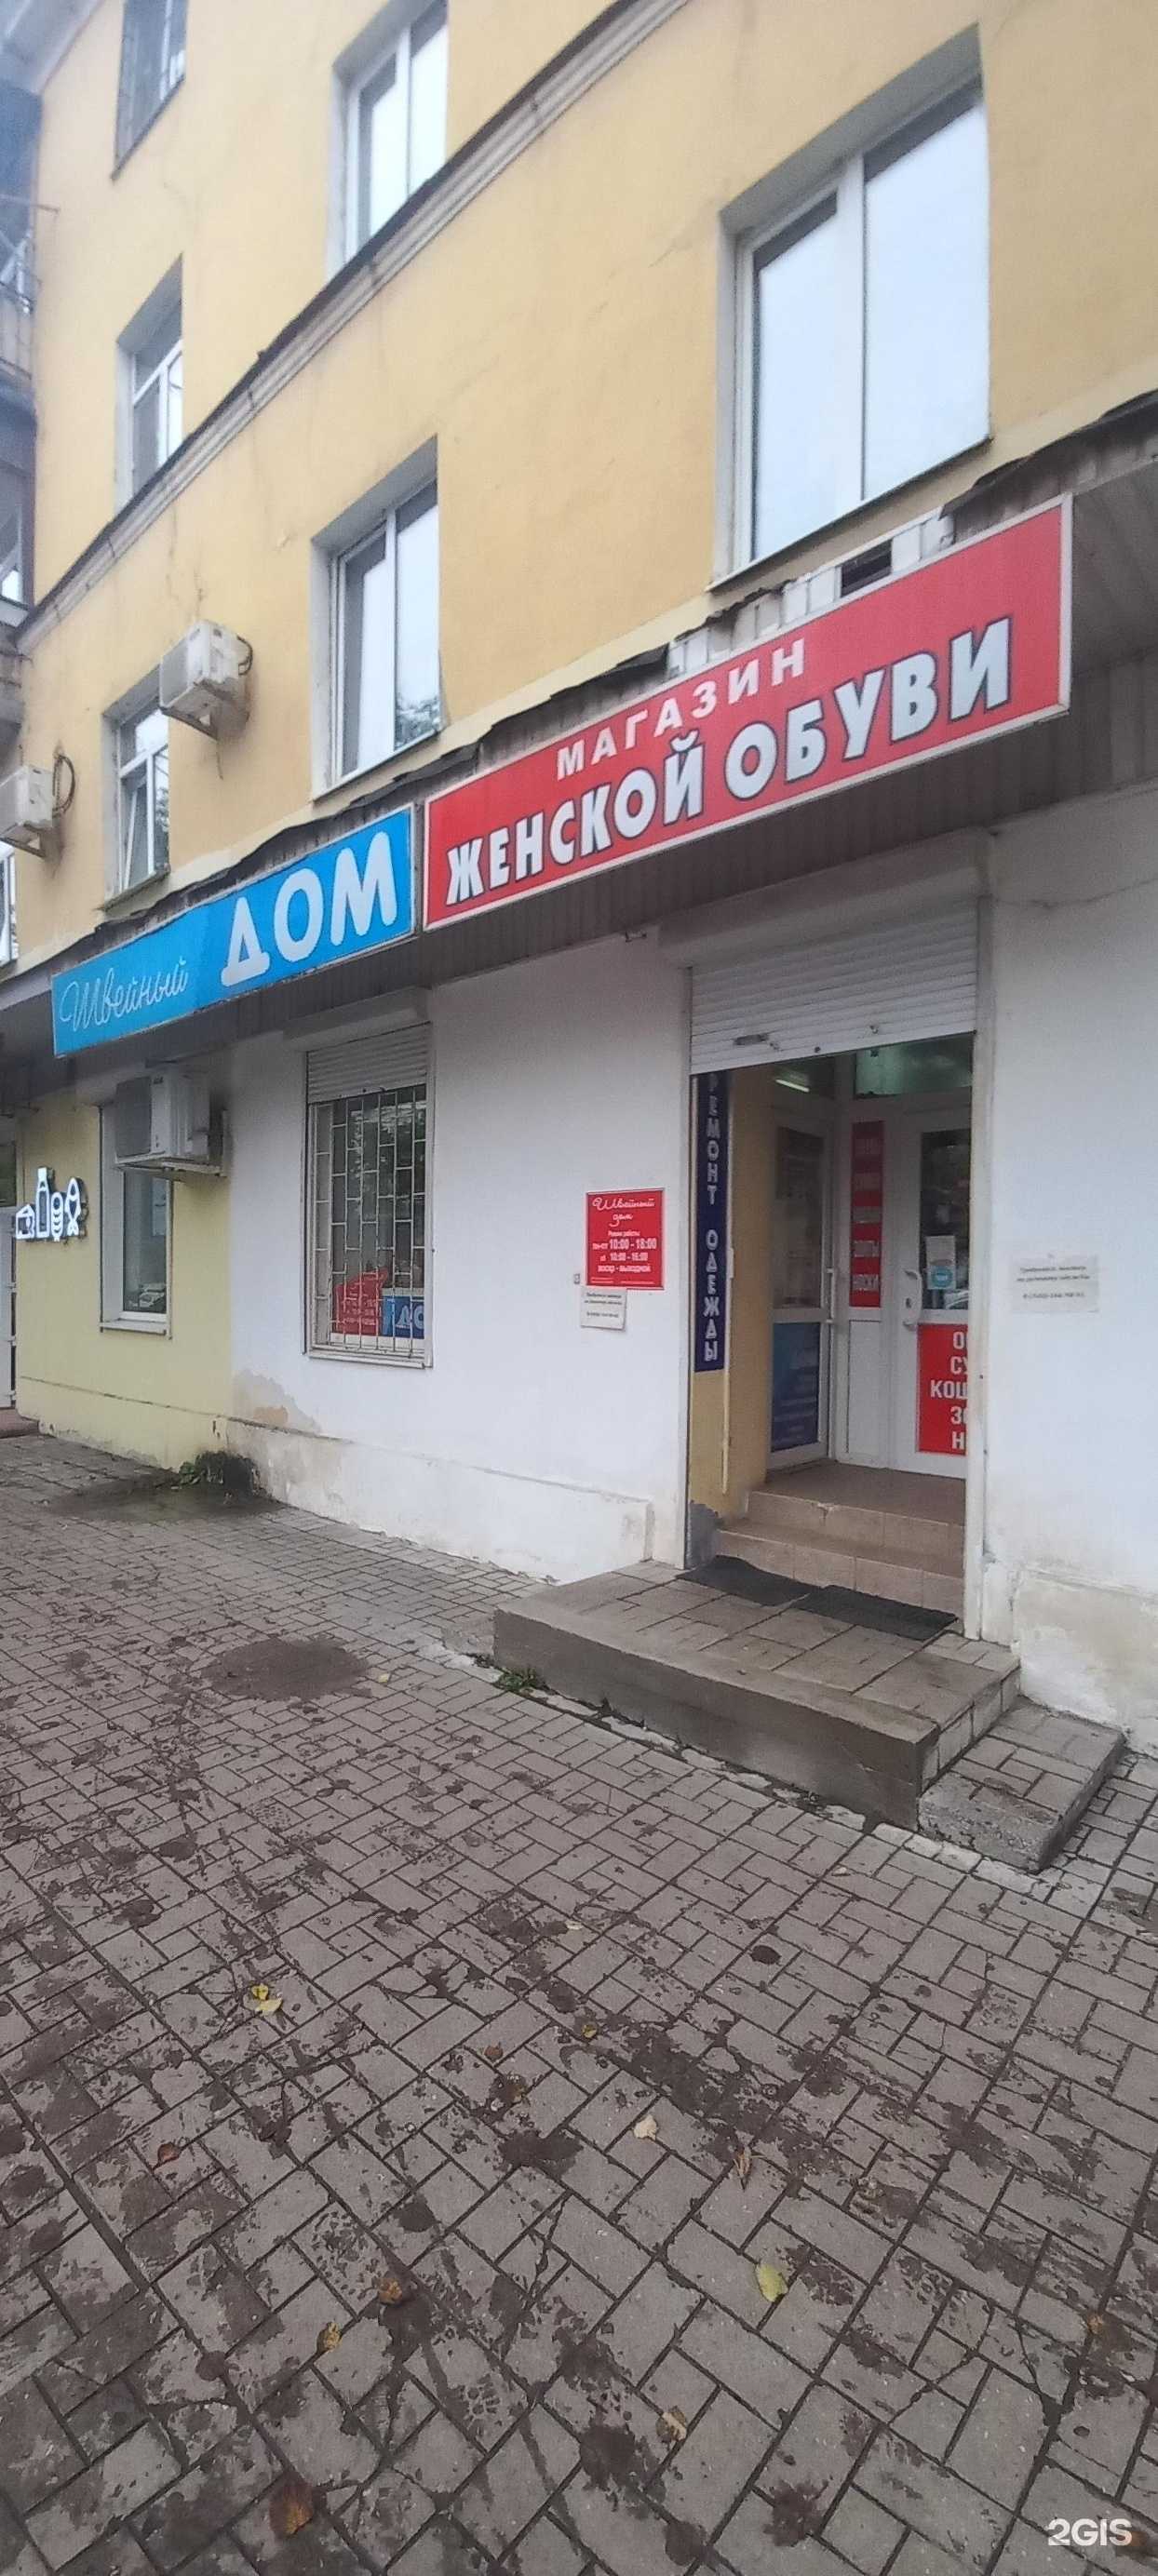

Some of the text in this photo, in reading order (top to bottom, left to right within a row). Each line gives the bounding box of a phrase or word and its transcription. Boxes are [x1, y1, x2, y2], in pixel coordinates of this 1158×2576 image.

[444, 614, 1013, 906] ЖЕНСКОЙ ОБУВИ
[557, 637, 806, 781] МАГАЗИН
[59, 831, 397, 1032] Швейный ДОМ
[609, 1238, 629, 1249] 10:00
[703, 1073, 720, 1362] РЕМОНТ ОДЕЖДЫ
